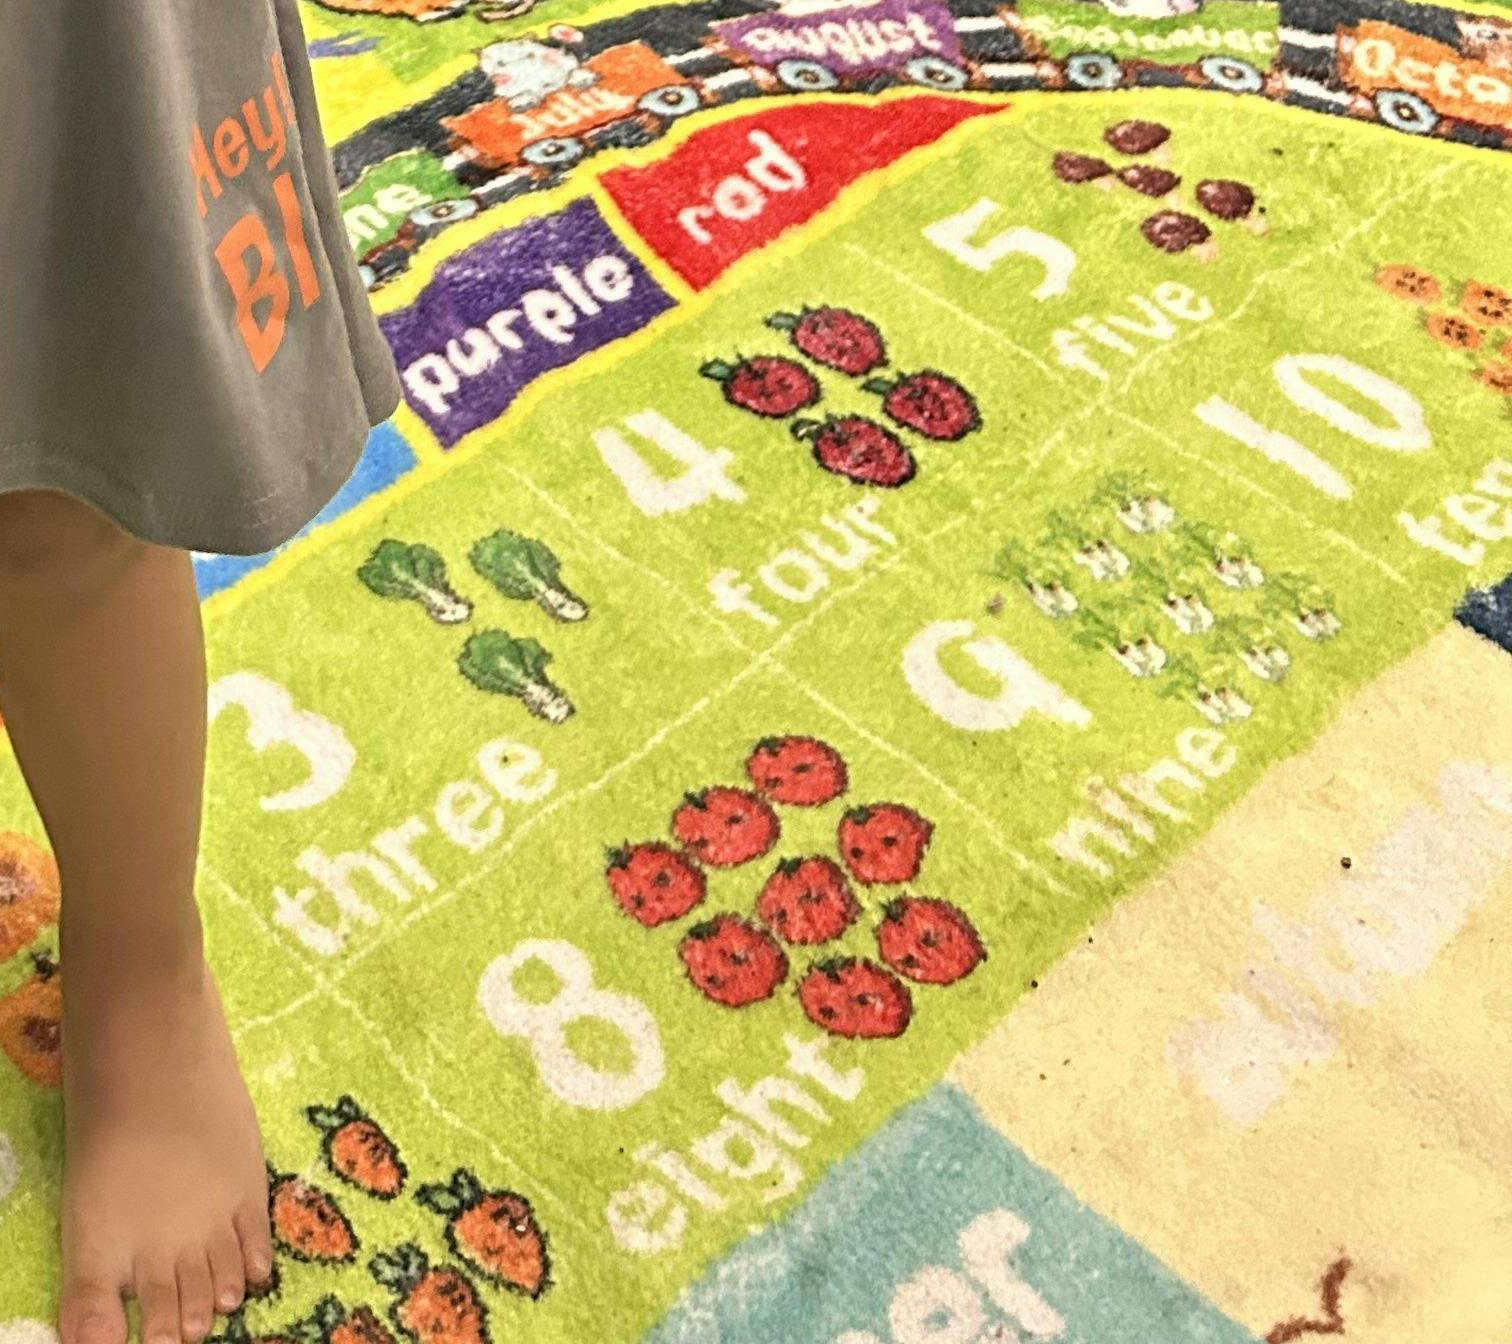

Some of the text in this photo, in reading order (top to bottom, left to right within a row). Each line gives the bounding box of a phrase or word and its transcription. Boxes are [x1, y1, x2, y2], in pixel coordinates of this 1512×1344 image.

[1352, 39, 1512, 105] Octo
[921, 196, 1077, 302] 5
[401, 255, 636, 414] purple
[1050, 279, 1214, 382] five
[592, 407, 747, 517] 4
[1193, 351, 1434, 502] 10
[707, 492, 901, 628] four
[205, 669, 357, 813] 3
[902, 618, 1095, 733] 9
[270, 736, 560, 959] three
[1046, 724, 1240, 877] nine
[474, 936, 667, 1111] 8
[605, 1029, 865, 1254] eight
